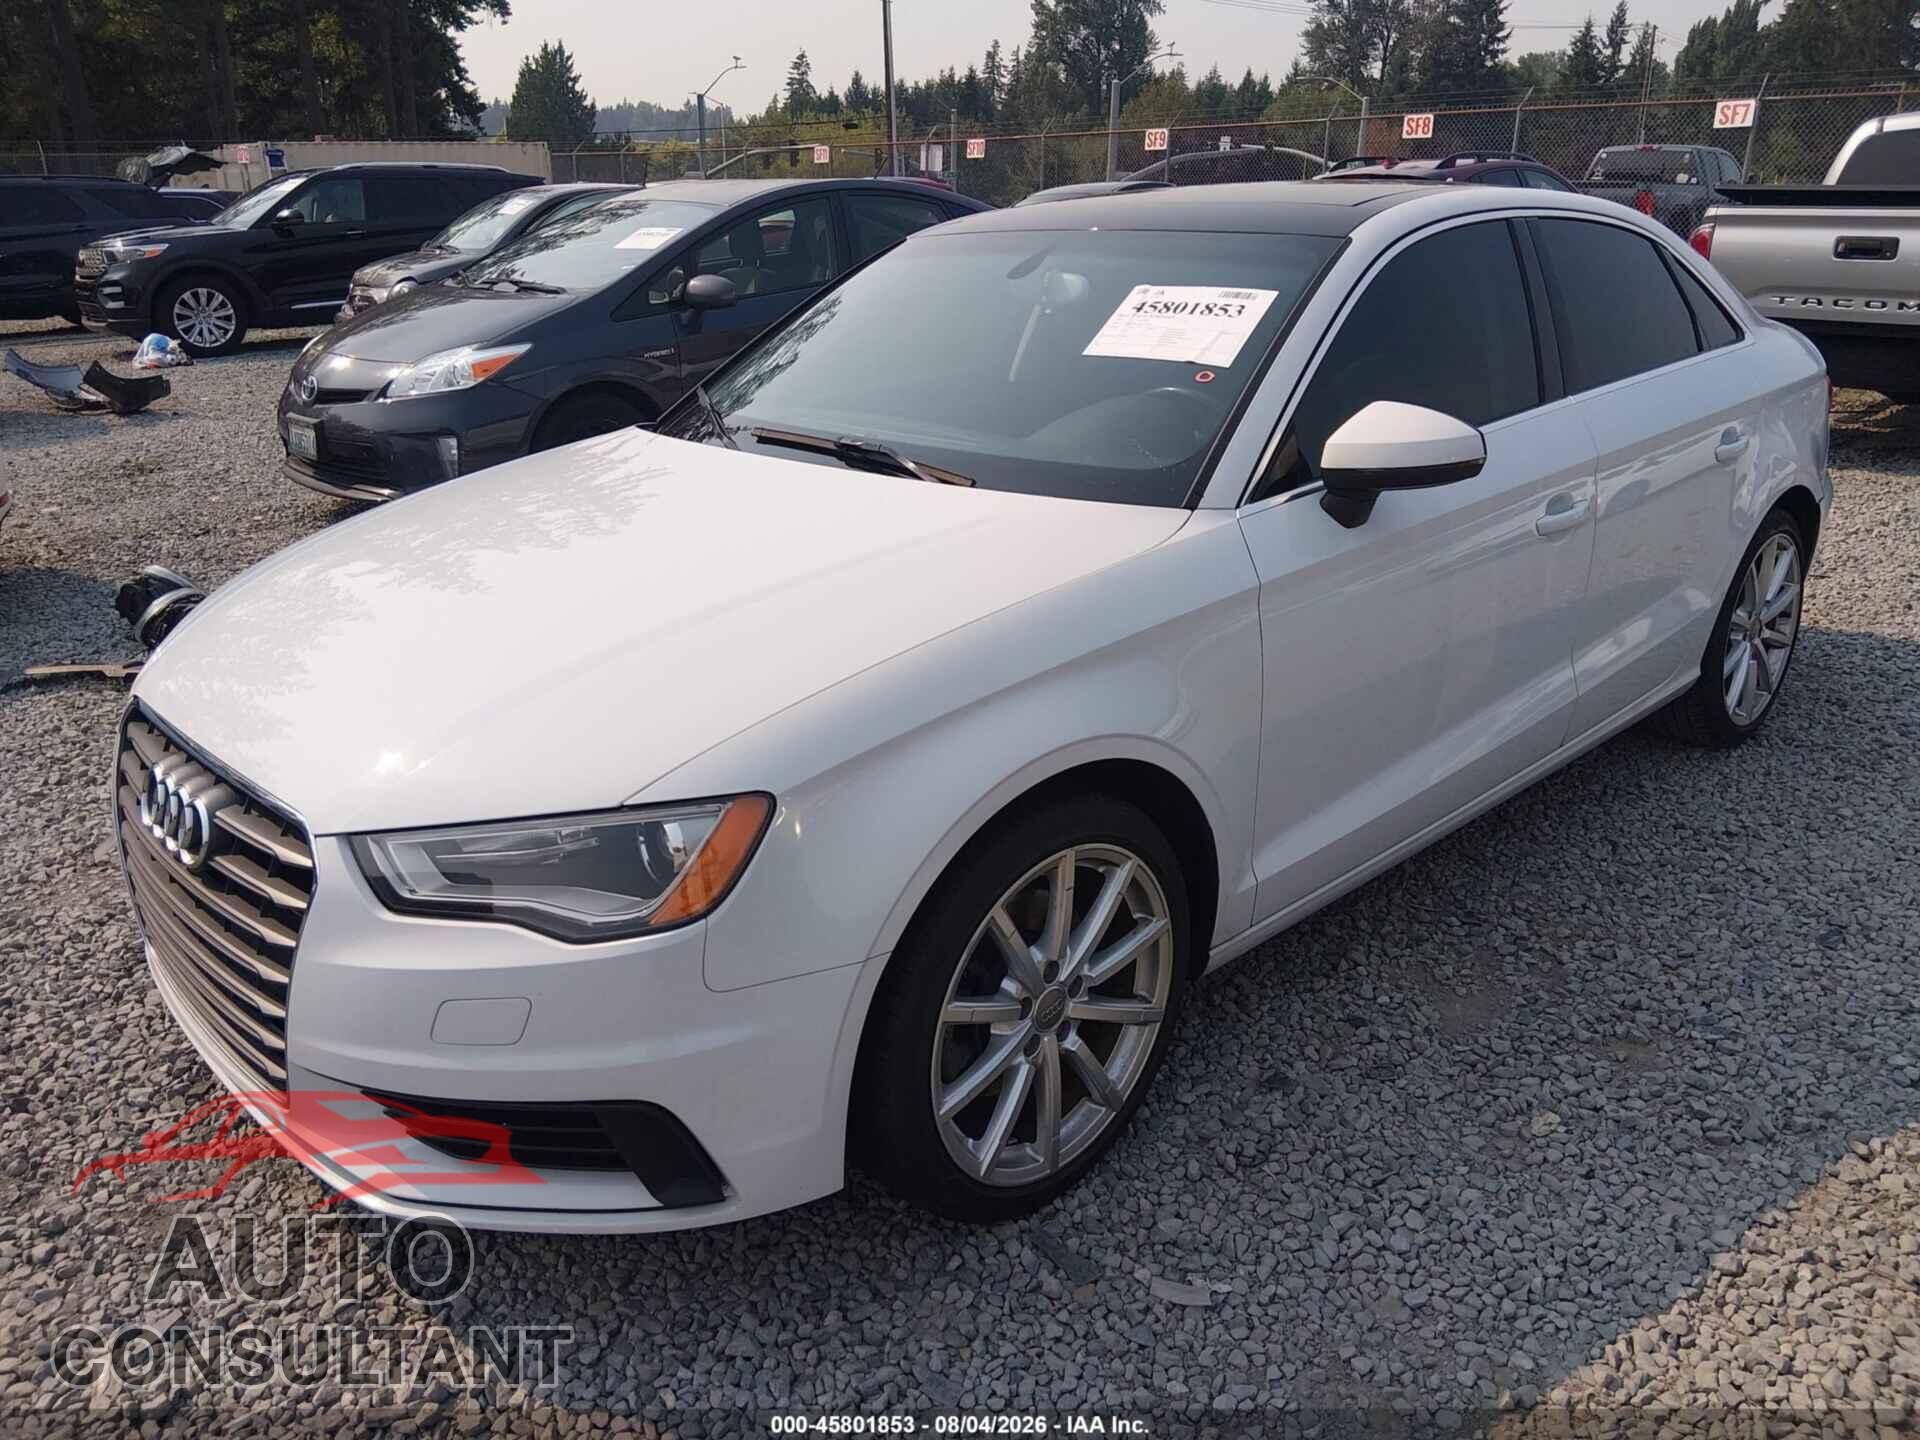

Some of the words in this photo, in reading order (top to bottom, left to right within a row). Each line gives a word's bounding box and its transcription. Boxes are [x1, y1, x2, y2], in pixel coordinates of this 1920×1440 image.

[1718, 103, 1751, 126] SF7
[1405, 117, 1431, 136] SF8
[1146, 131, 1167, 148] SF9
[1132, 300, 1246, 319] 45801853
